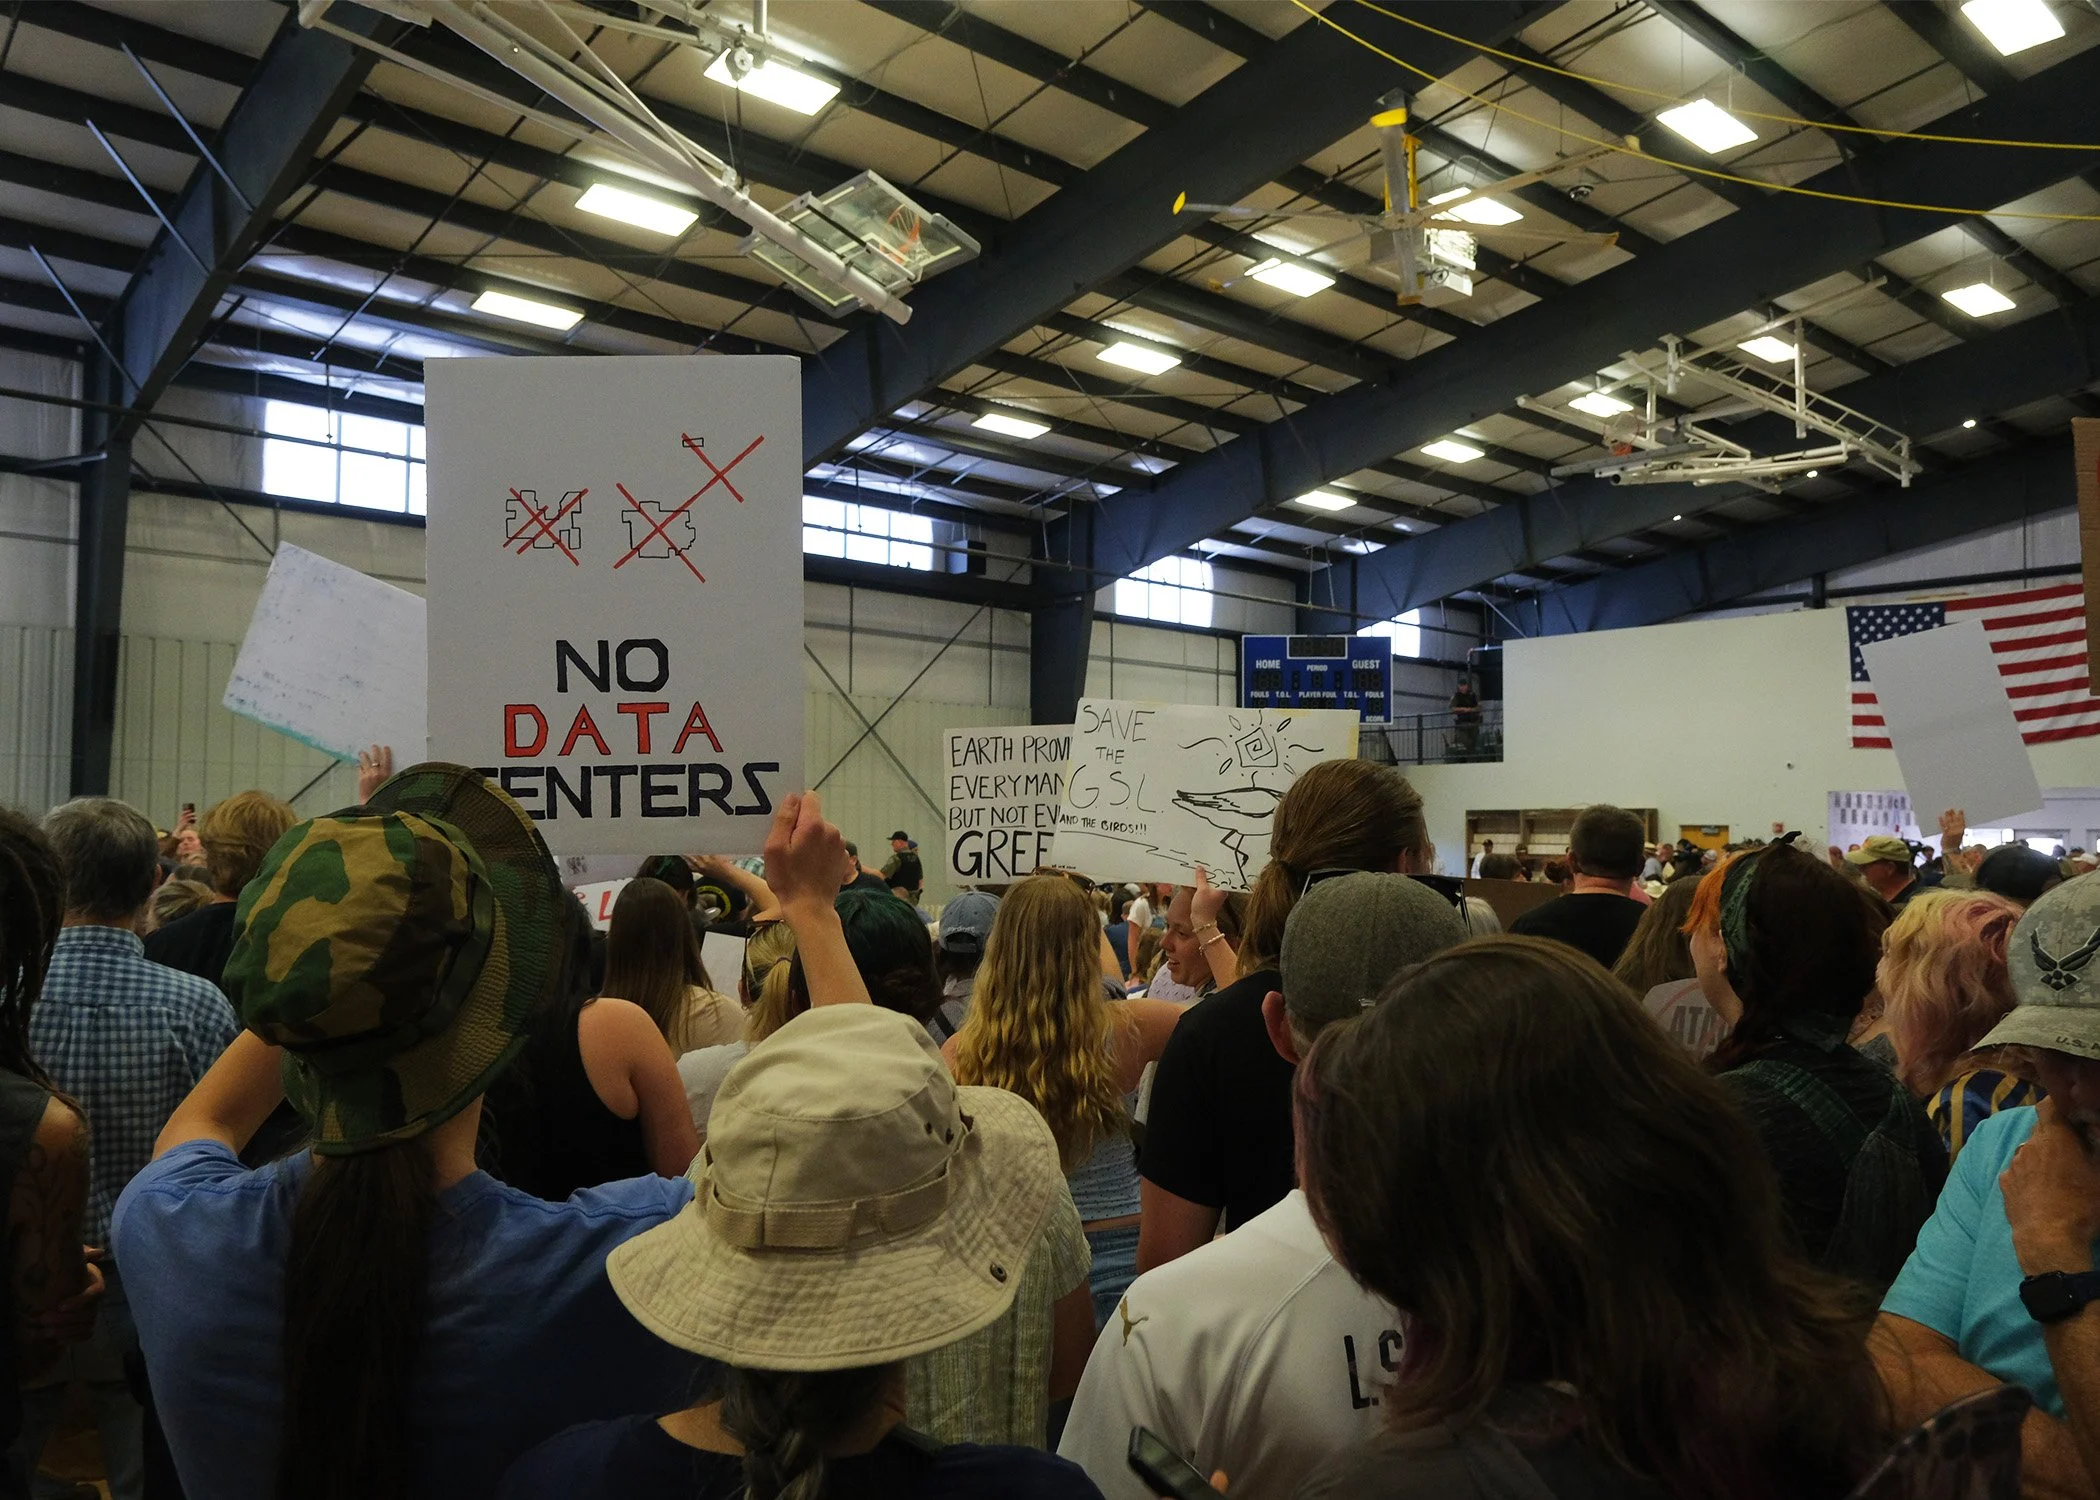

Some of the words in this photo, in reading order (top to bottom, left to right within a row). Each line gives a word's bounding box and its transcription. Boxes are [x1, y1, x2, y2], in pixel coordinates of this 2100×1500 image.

[556, 638, 669, 693] NO
[1255, 660, 1281, 669] HOME
[1306, 664, 1328, 672] PERIOD
[1352, 660, 1380, 669] GUEST
[504, 700, 724, 758] DATA
[1083, 705, 1155, 742] SAVE
[951, 736, 1012, 767] EARTH
[1095, 746, 1125, 764] THE
[949, 806, 986, 831] BUT
[990, 805, 1029, 826] NOT
[1034, 803, 1061, 828] EV
[1059, 814, 1079, 825] AND
[1081, 817, 1097, 828] THE
[1100, 820, 1147, 836] BIRDS!!!
